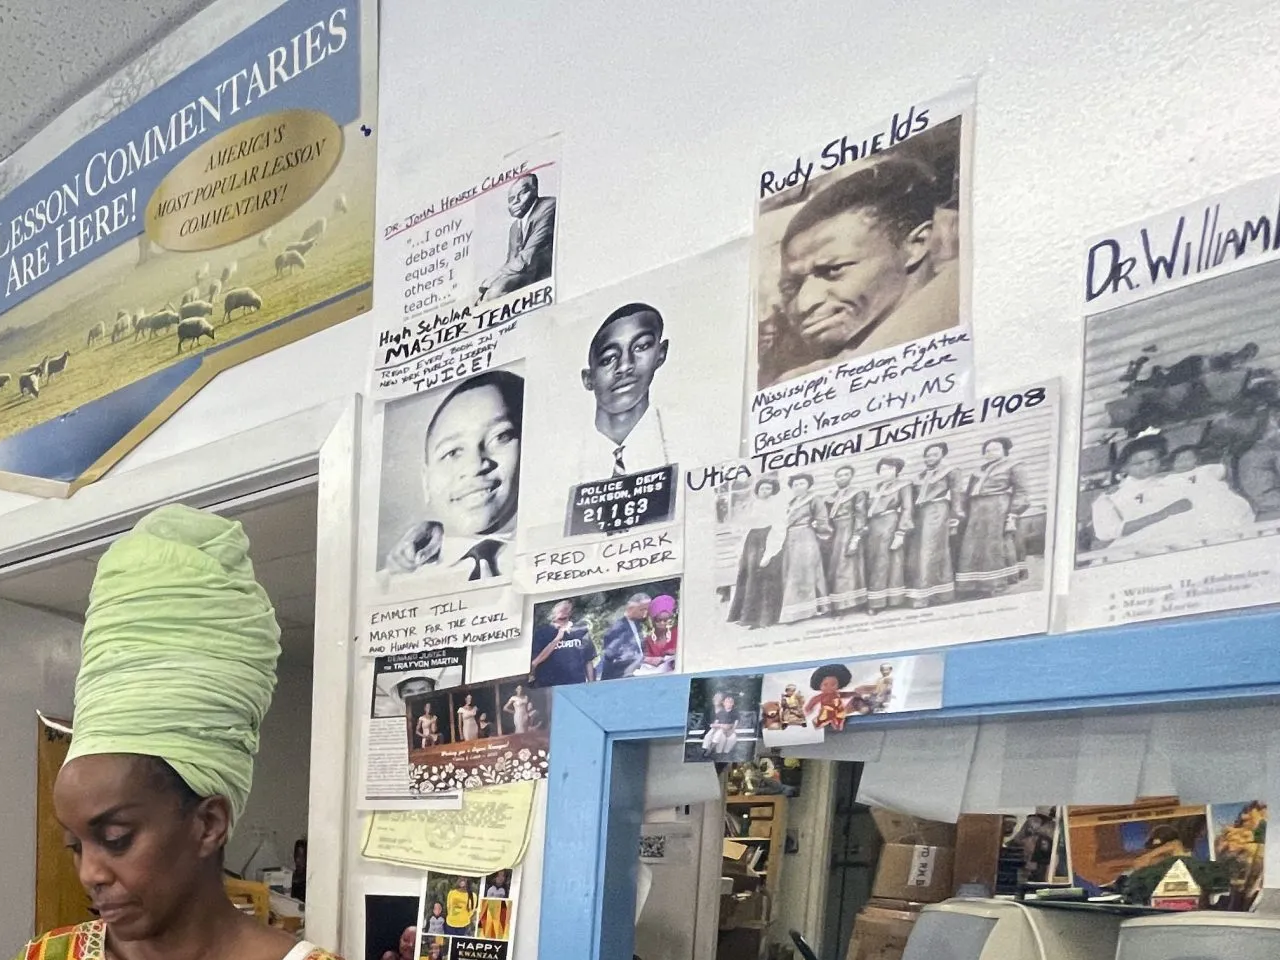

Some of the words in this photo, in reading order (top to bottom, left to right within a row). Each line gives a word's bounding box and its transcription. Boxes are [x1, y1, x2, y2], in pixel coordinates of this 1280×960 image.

[84, 8, 347, 197] COMMENTARIES
[205, 124, 286, 173] AMERICA'S
[155, 192, 194, 220] MOST
[193, 166, 260, 205] POPULAR
[261, 138, 326, 181] LESSON
[760, 157, 814, 198] Rudy
[180, 184, 287, 237] COMMENTARY!
[406, 204, 435, 227] JOHN
[5, 243, 50, 297] ARE
[56, 188, 137, 266] HERE!
[435, 218, 463, 238] only
[405, 240, 449, 266] debate
[452, 230, 473, 249] my
[405, 257, 450, 283] equals,
[454, 245, 469, 262] all
[404, 277, 444, 298] others
[385, 322, 468, 364] MASTER
[473, 286, 553, 329] TEACHER
[382, 366, 410, 378] READ
[416, 351, 445, 370] EVERY
[451, 343, 473, 355] BOOK
[478, 334, 493, 346] IN
[499, 320, 517, 336] THE
[379, 378, 398, 388] NEW
[423, 358, 454, 375] PUBLIC
[413, 351, 493, 391] TWICE!
[835, 356, 897, 380] Freedom
[919, 372, 956, 399] MS
[758, 388, 837, 424] Boycott
[980, 387, 1047, 423] 1908
[576, 489, 631, 506] JACKSON,
[633, 482, 663, 496] MISS
[581, 481, 624, 496] POLICE
[636, 471, 667, 486] DEPT.
[535, 551, 585, 567] FRED
[602, 532, 672, 558] CLARK
[617, 551, 676, 572] RIDER
[430, 600, 468, 616] TILL
[369, 626, 417, 643] MARTYR
[425, 624, 443, 634] FOR
[448, 618, 466, 630] THE
[471, 613, 508, 626] CIVIL
[369, 645, 385, 653] AND
[390, 641, 420, 653] HUMAN
[463, 627, 521, 643] MOVEMENTS
[393, 660, 429, 670] TRAYVON
[431, 656, 459, 665] MARTIN
[456, 941, 502, 953] HAPPY
[458, 950, 499, 960] KWANZAA
